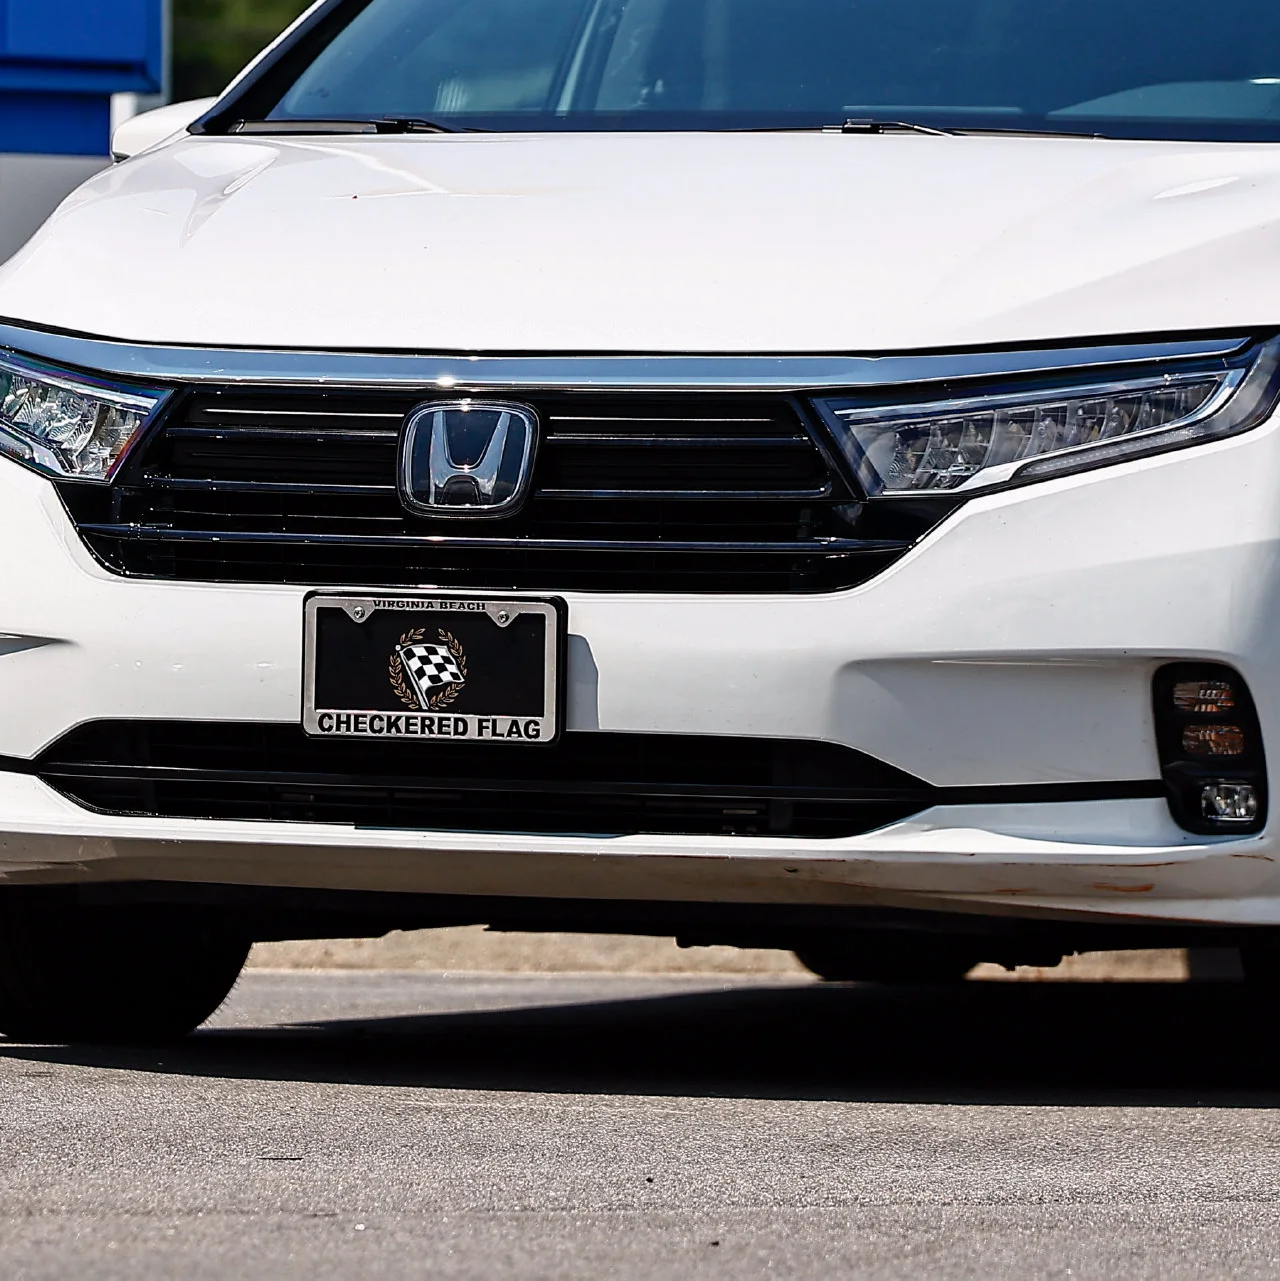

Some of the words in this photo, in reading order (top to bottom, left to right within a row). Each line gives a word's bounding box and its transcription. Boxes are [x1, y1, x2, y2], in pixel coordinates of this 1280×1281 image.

[372, 599, 436, 611] VIRGINIA
[439, 601, 486, 612] BEACH
[317, 712, 469, 737] CHECKERED
[477, 719, 541, 740] FLAG
